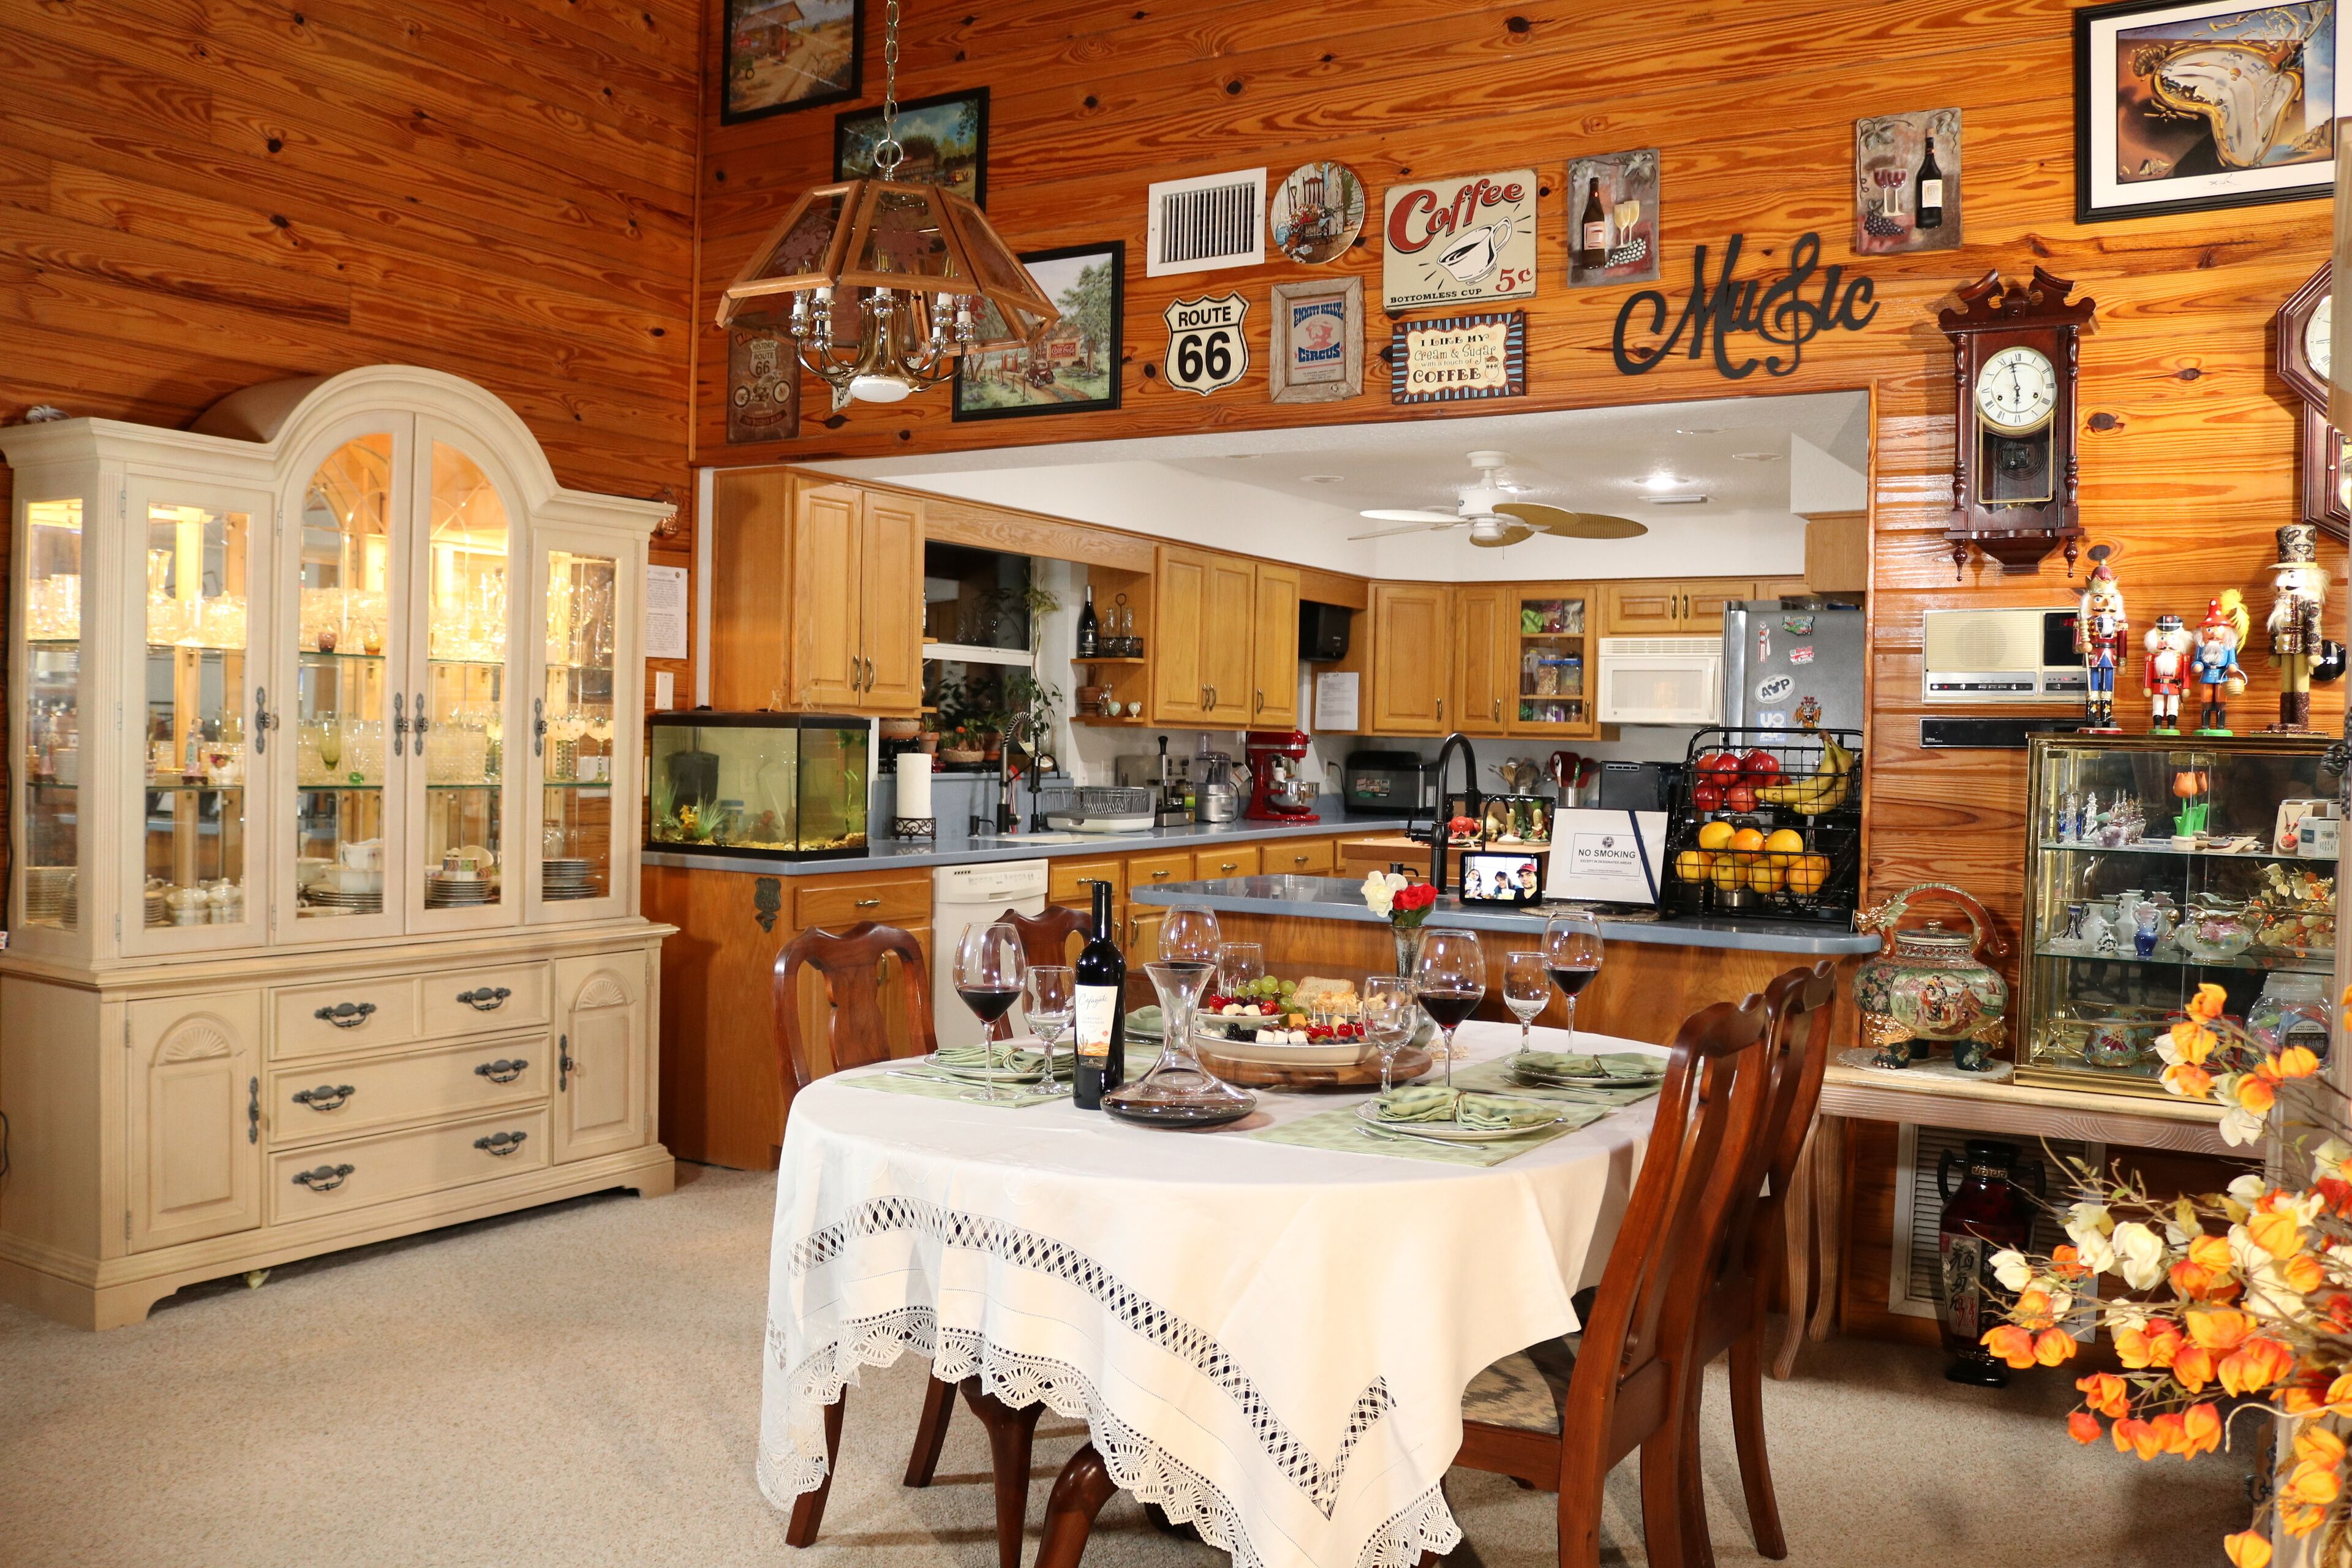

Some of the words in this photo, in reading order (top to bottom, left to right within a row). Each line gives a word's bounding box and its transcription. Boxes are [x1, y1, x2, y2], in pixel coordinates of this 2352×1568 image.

[1387, 178, 1525, 254] Coffee
[1495, 268, 1533, 292] 5¢
[1390, 291, 1457, 304] BOTTOMLESS
[1613, 232, 1880, 380] Music
[1178, 306, 1231, 327] ROUTE
[1294, 305, 1320, 329] EMMETT
[752, 341, 775, 352] HISTORIC
[1430, 336, 1463, 346] LIKE
[1468, 334, 1490, 342] MY
[754, 352, 774, 360] ROUTE
[1178, 331, 1232, 383] 66
[1414, 350, 1447, 361] Cream
[1451, 349, 1459, 359] &
[1462, 344, 1496, 365] Sugar
[755, 360, 770, 375] 66
[1413, 368, 1481, 383] COFFEE
[1594, 850, 1636, 858] SMOKING
[2307, 1039, 2324, 1048] HAND
